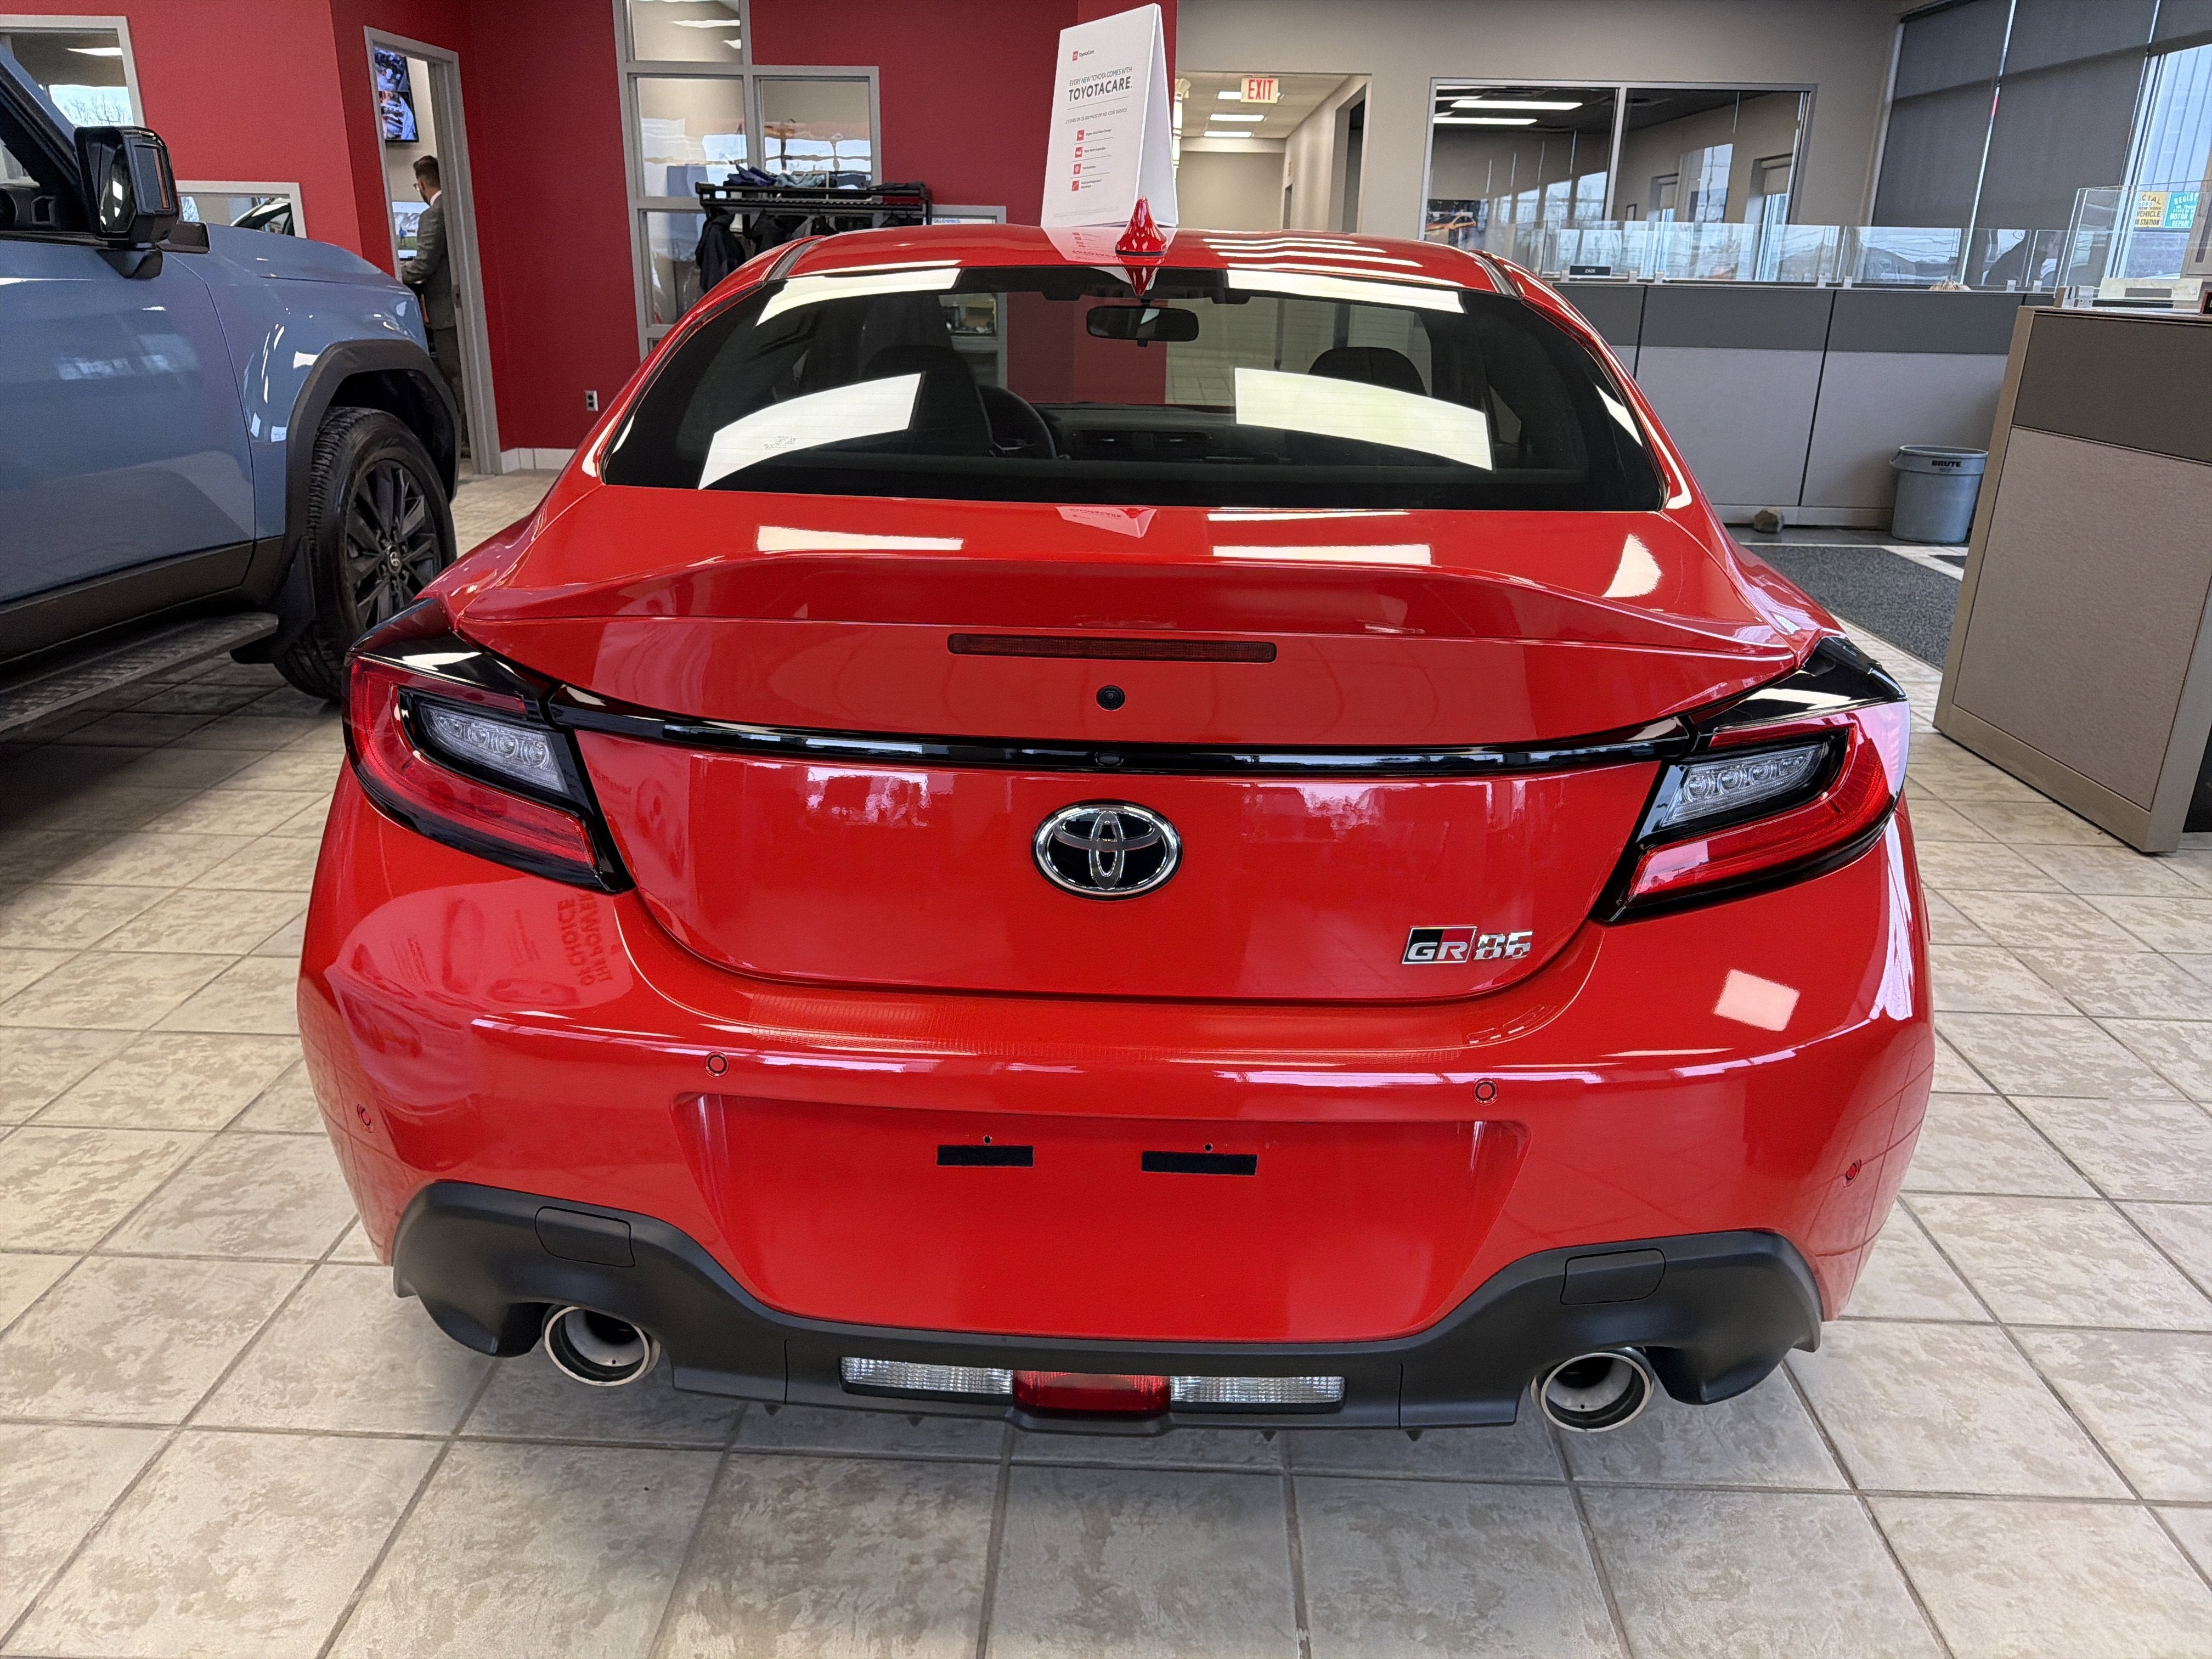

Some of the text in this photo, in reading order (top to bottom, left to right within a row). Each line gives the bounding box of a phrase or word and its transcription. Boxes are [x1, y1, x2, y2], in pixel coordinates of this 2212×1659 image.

[1069, 66, 1132, 87] EVERY NEW TOYOTA COMES WITH
[1248, 79, 1274, 100] EXIT
[1407, 931, 1533, 961] GR 86
